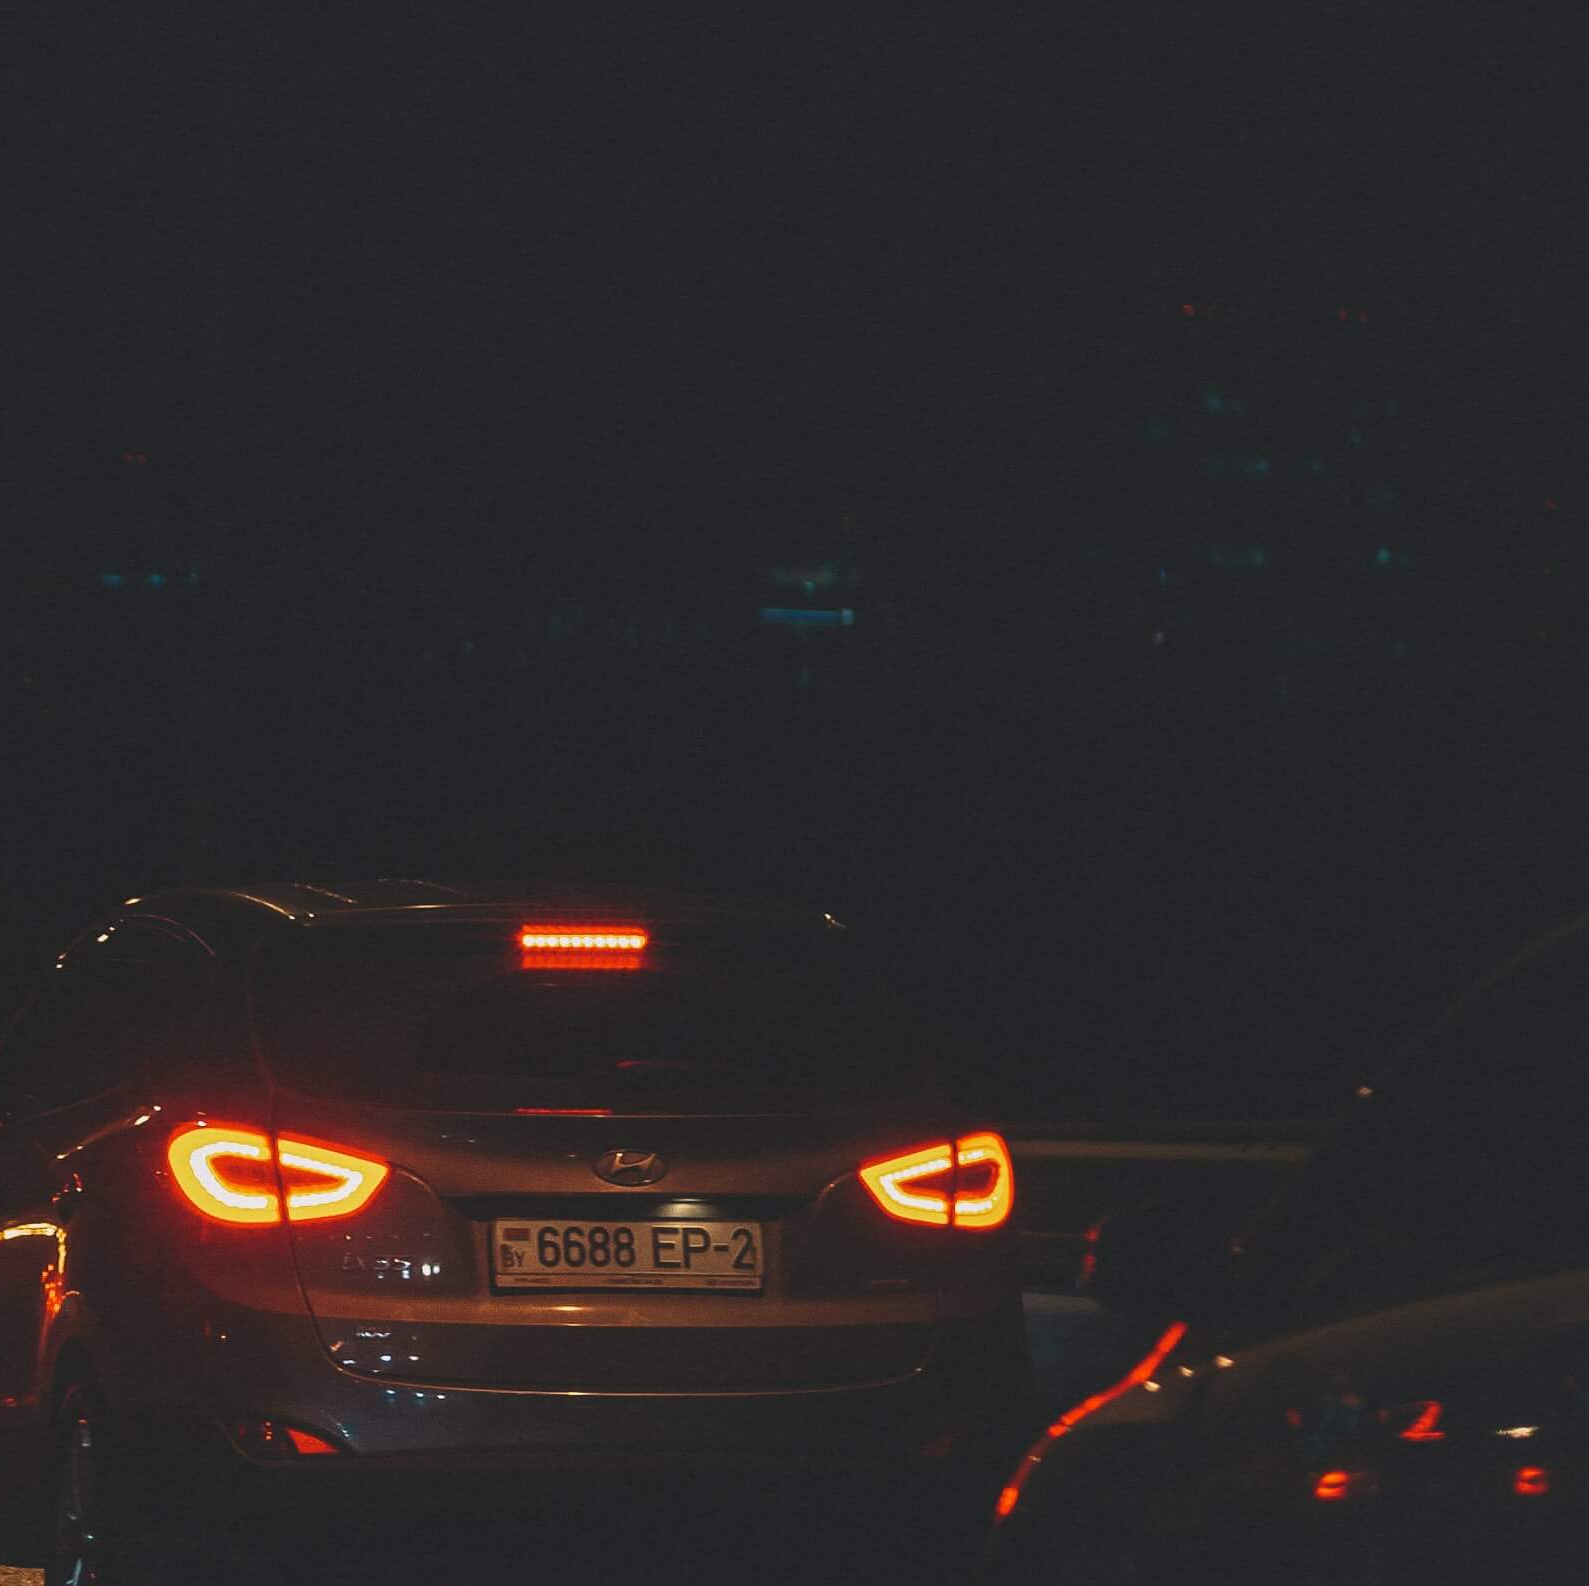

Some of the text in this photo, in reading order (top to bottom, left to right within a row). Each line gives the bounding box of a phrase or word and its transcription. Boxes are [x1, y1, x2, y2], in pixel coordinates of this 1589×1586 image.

[500, 1243, 525, 1268] BY
[537, 1226, 757, 1270] 6688 EP-2
